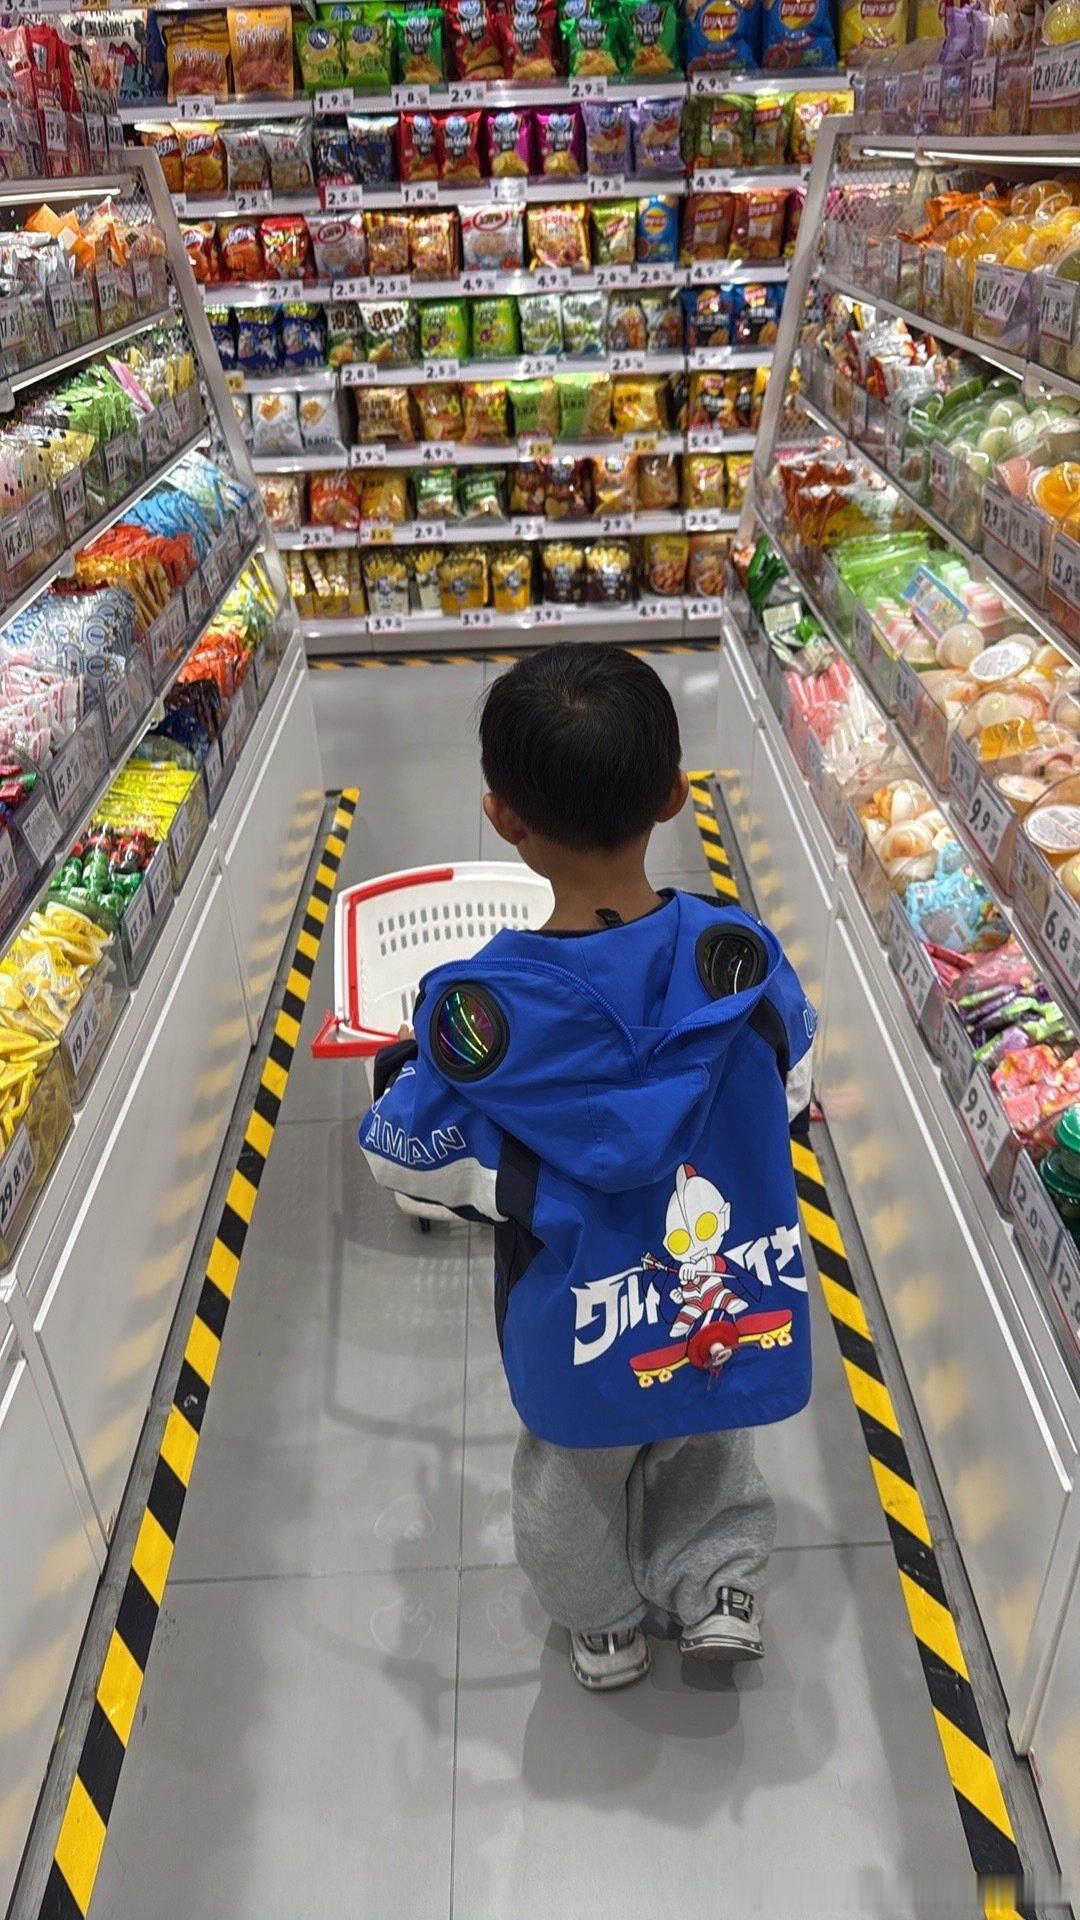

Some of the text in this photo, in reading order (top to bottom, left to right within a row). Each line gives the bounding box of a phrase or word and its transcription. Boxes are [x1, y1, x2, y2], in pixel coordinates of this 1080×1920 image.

[451, 88, 472, 102] 2.9
[572, 83, 593, 97] 2.9
[319, 90, 339, 108] 1.9
[180, 102, 200, 116] 1.9
[590, 180, 610, 194] 1.9
[463, 277, 483, 291] 4.9
[537, 275, 557, 288] 4.9
[969, 797, 991, 833] 9.9
[1045, 909, 1071, 953] 6.8
[964, 1087, 988, 1130] 9.9
[1014, 1176, 1037, 1230] 12.0
